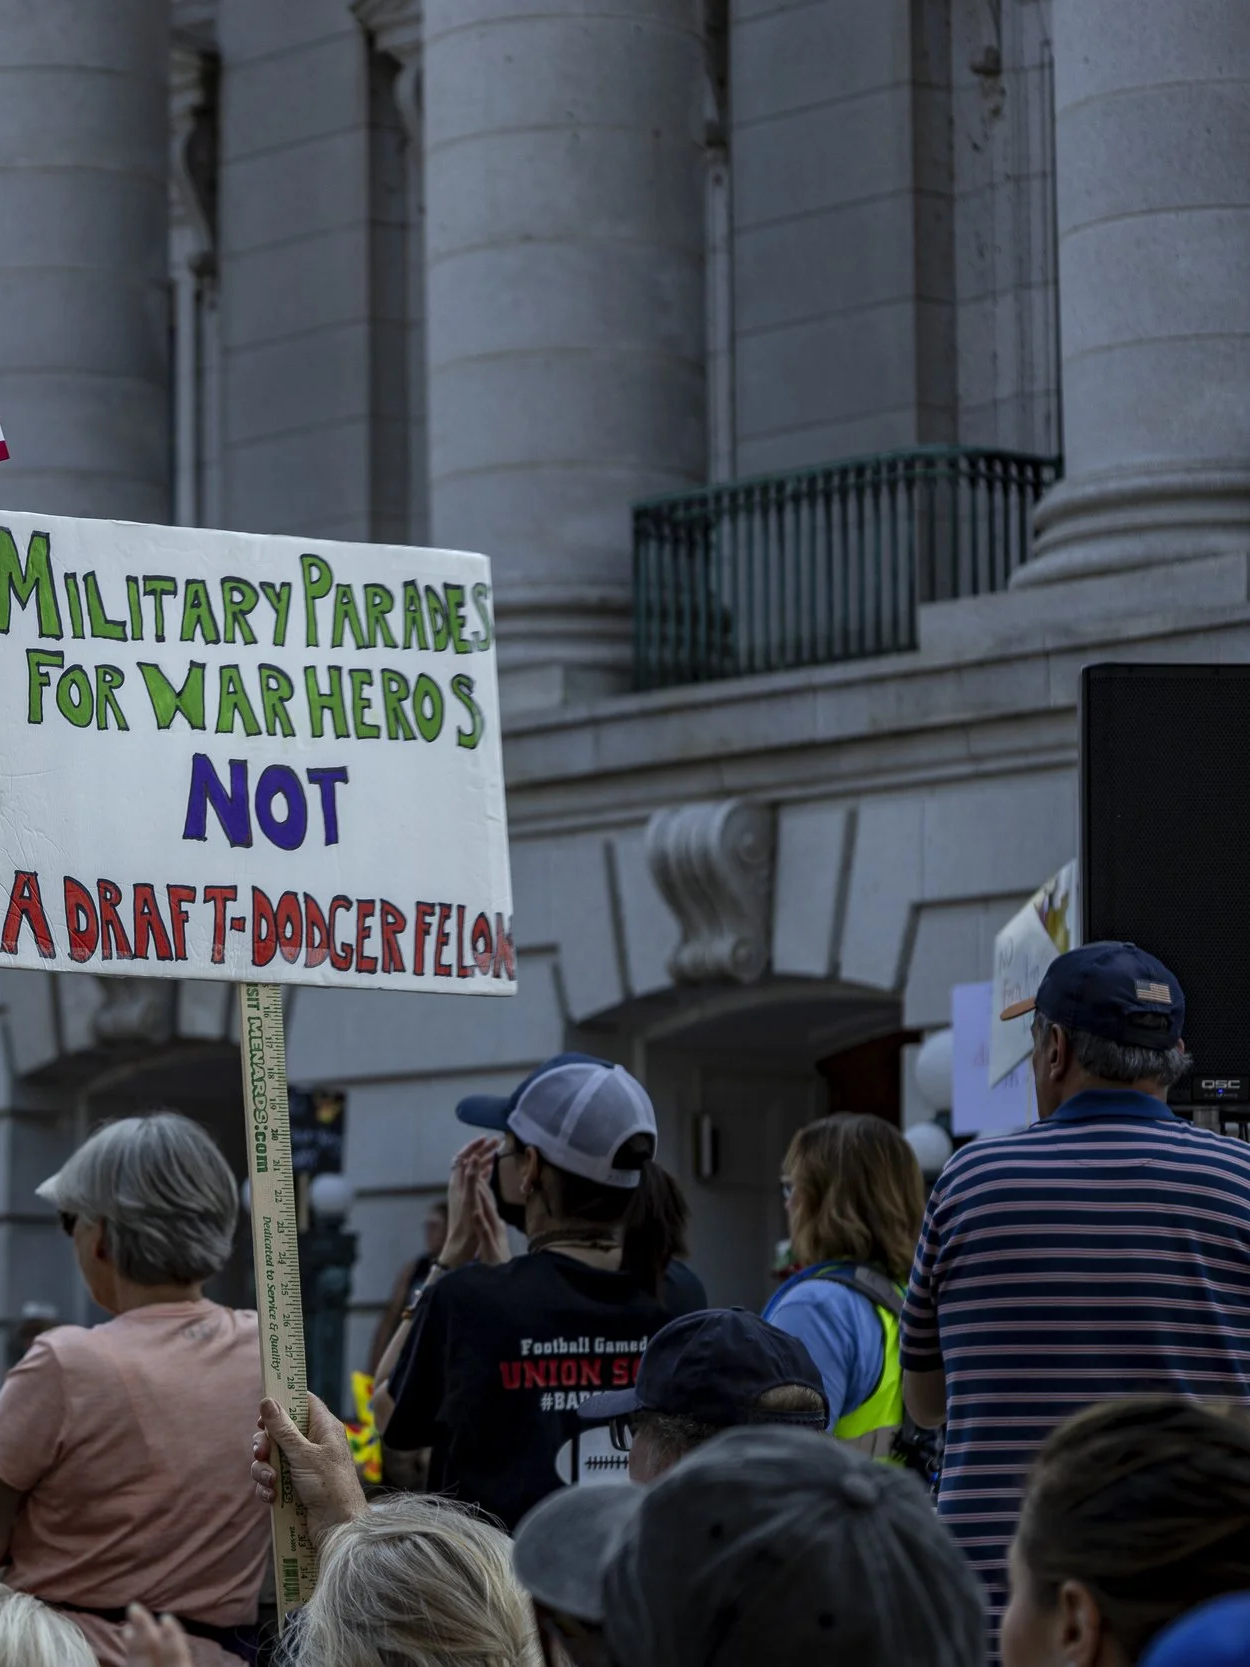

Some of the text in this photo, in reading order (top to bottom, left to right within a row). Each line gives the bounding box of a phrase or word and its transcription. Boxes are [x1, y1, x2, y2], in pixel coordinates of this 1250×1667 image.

[300, 553, 492, 654] PARADES
[25, 648, 484, 749] FOR WAR HEROS
[182, 752, 349, 851] NOT
[0, 870, 54, 960] A
[414, 900, 516, 981] FELON
[246, 982, 261, 1011] ISIT
[1201, 1079, 1241, 1089] QSC
[262, 1216, 274, 1267] Dedicated
[265, 1268, 275, 1281] to
[266, 1282, 278, 1320] Service
[520, 1336, 648, 1356] Football Gamed
[500, 1359, 601, 1389] UNION
